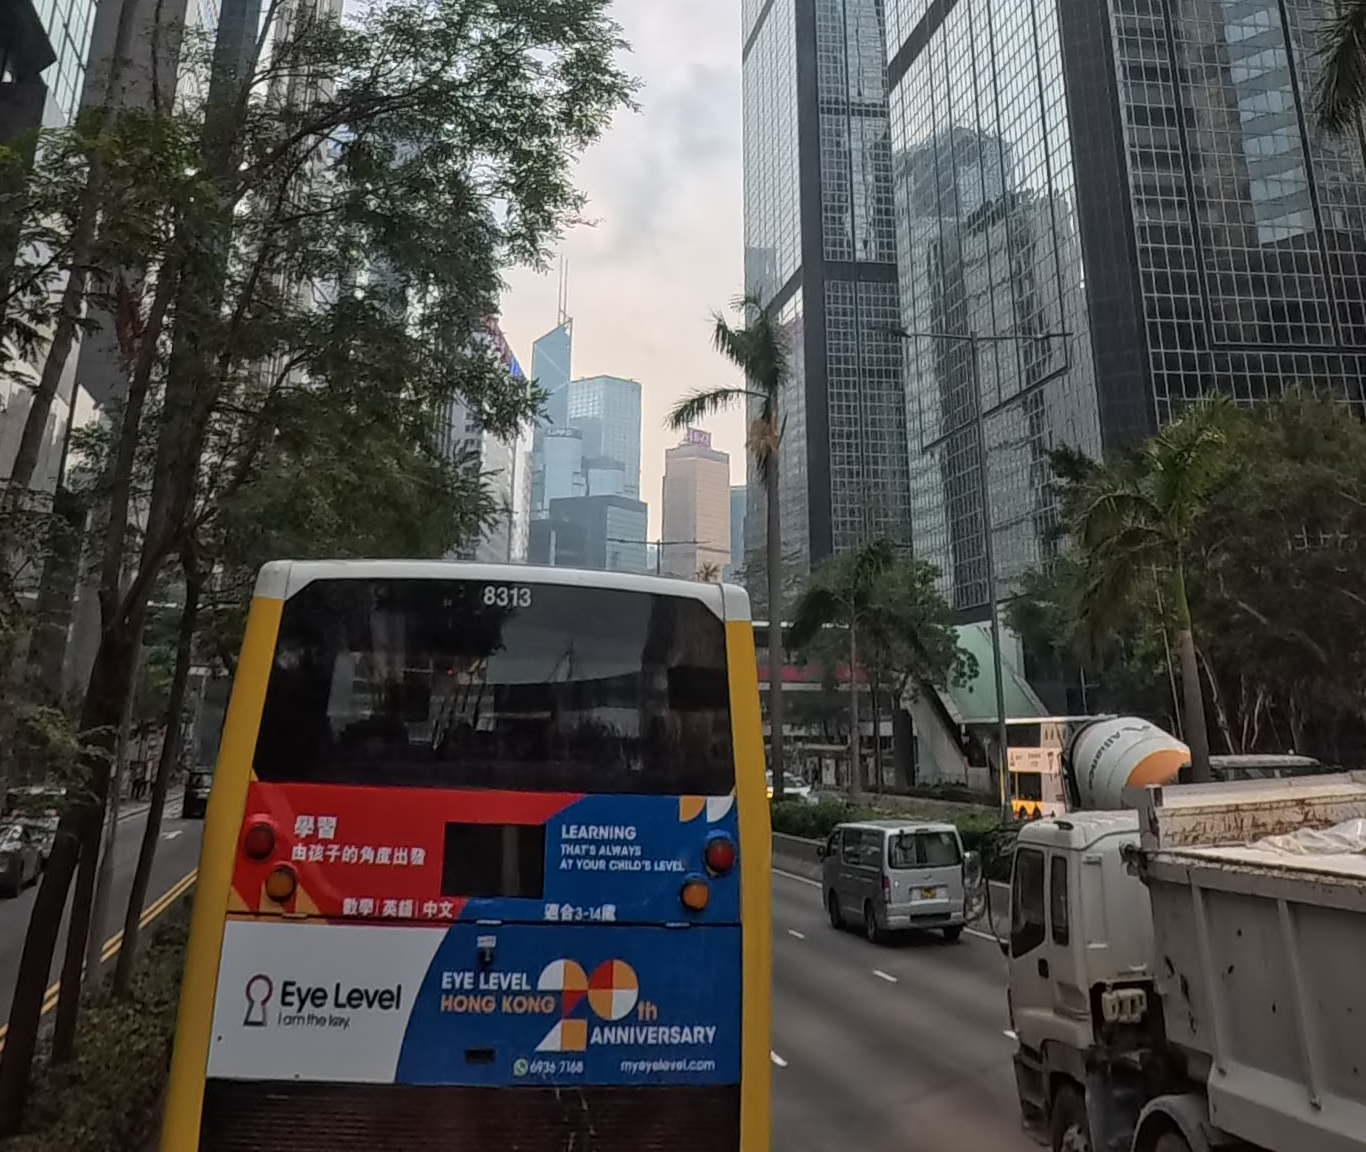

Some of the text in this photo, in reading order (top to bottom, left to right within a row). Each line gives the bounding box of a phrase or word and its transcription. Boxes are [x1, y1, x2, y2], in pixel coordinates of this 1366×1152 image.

[483, 585, 532, 608] 8313
[294, 815, 338, 840] 學習
[561, 824, 637, 840] LEARNING
[291, 844, 427, 866] 由孩子的角度出發
[561, 843, 642, 857] THAT'S ALWAYS
[559, 858, 686, 872] AT YOUR CHILD'S LEVEL
[441, 971, 532, 991] EYE LEVEL
[280, 980, 403, 1014] Eye Level
[440, 994, 557, 1014] HONG KONG
[283, 1014, 305, 1026] am
[306, 1013, 327, 1027] the
[589, 1025, 717, 1045] ANNIVERSARY
[619, 1057, 716, 1075] myeyelevel.com
